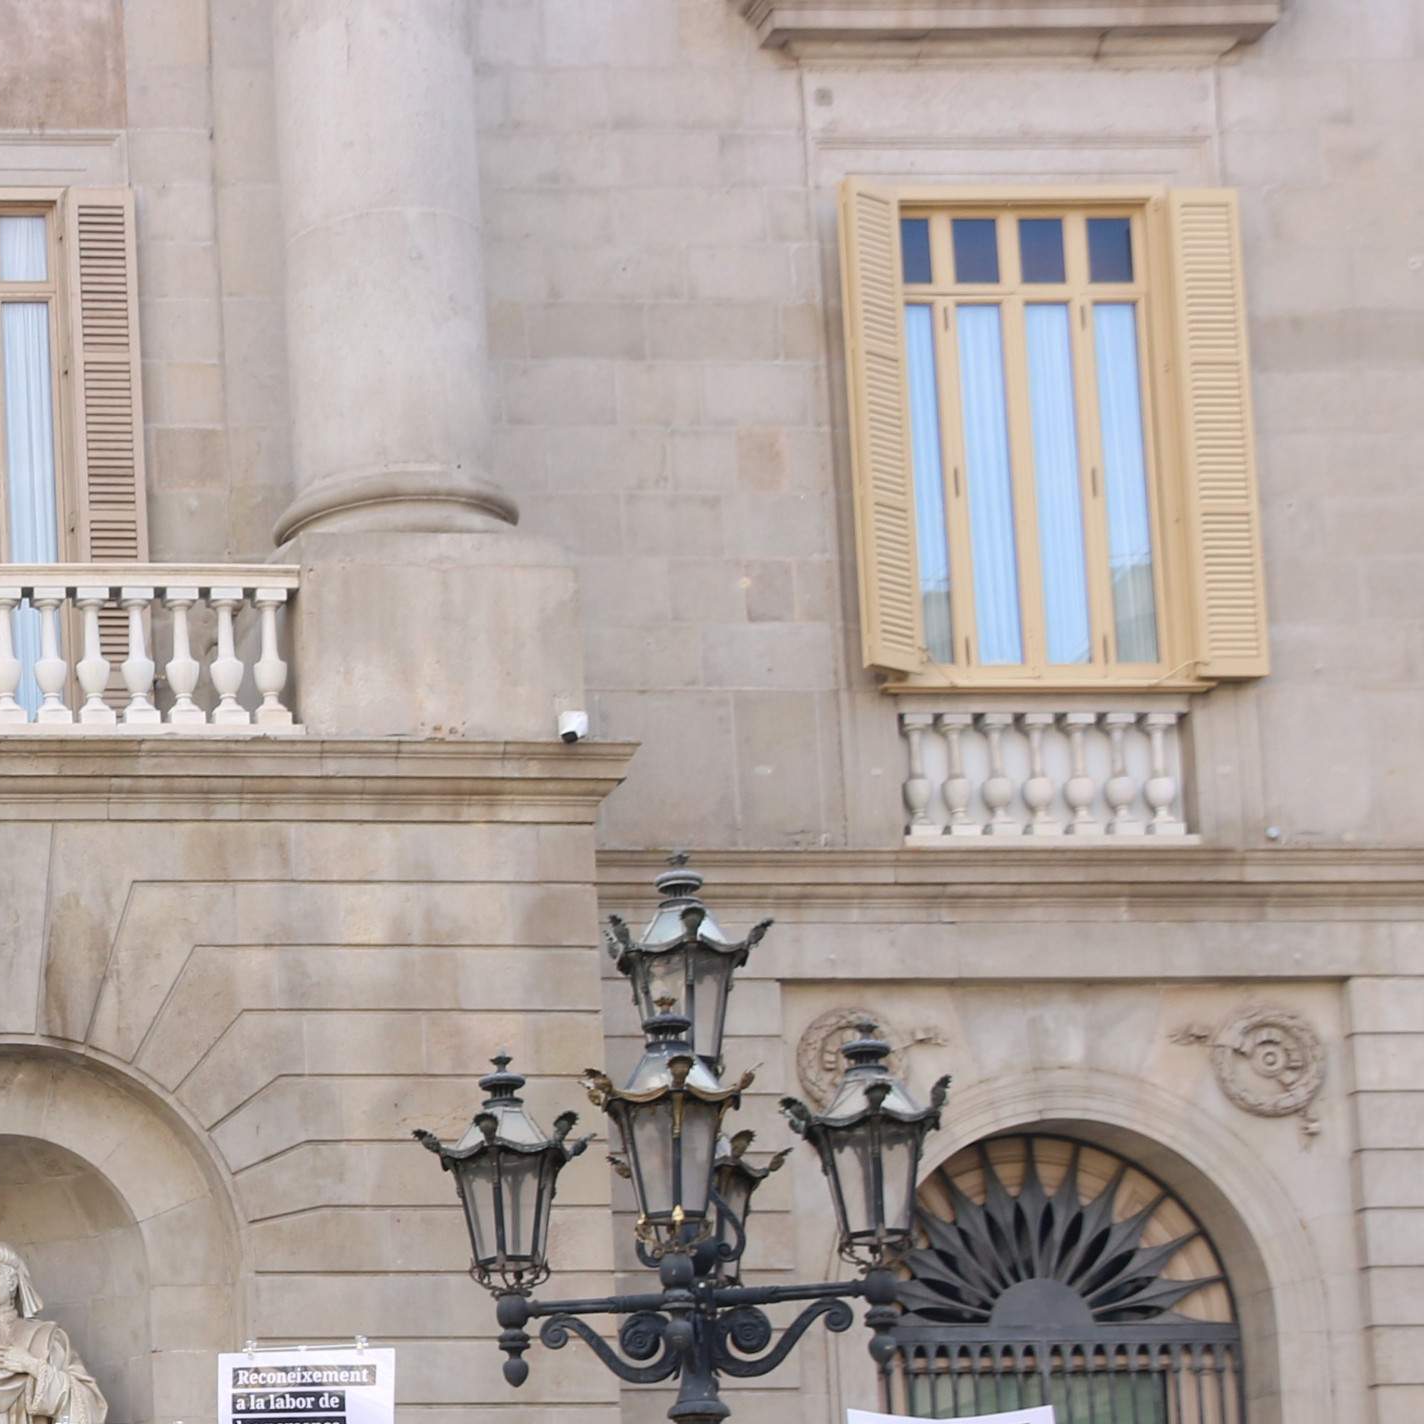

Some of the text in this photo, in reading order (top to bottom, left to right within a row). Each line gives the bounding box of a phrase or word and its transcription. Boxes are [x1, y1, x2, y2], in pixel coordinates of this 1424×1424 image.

[237, 1367, 369, 1386] Reconeixement
[235, 1391, 340, 1411] a la labor de
